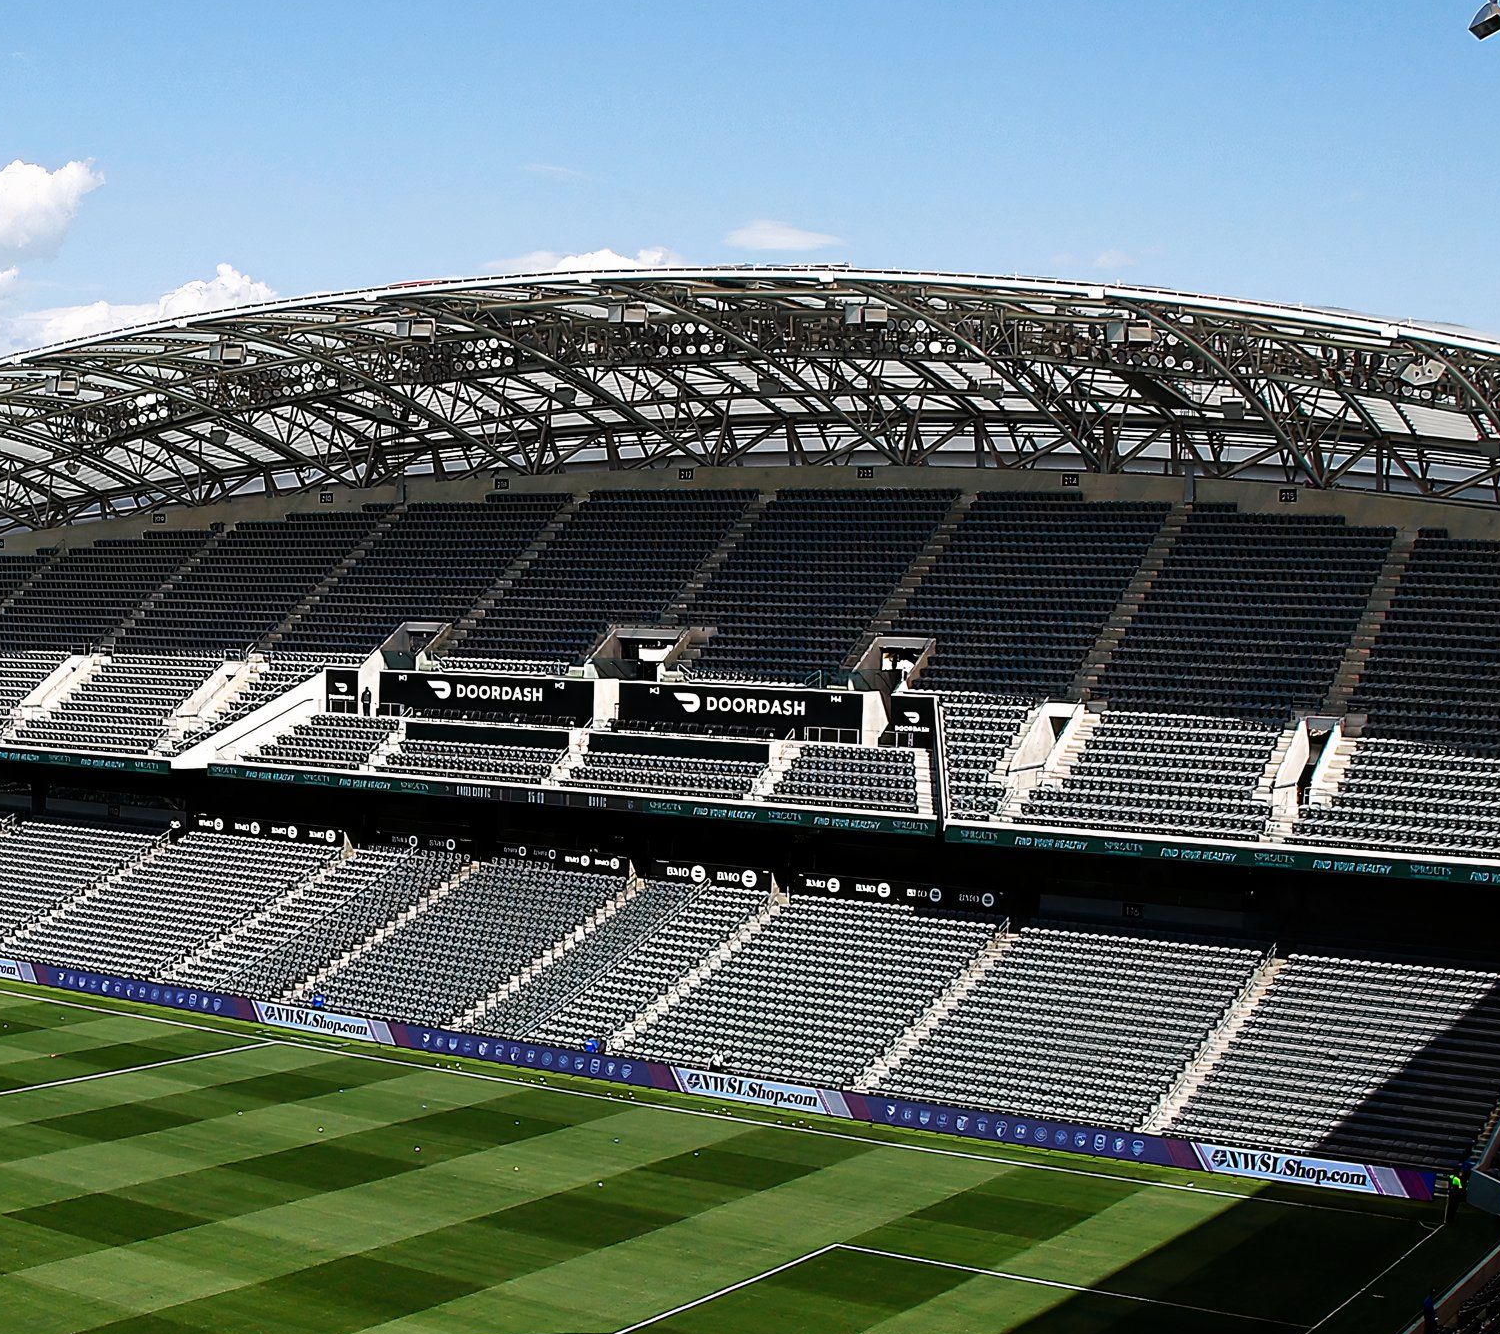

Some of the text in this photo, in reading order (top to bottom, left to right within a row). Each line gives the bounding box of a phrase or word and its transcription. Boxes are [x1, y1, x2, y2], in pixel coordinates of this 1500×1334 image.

[456, 683, 543, 702] DOORDASH
[706, 695, 806, 716] DOORDASH
[960, 829, 998, 840] SPROUTS
[1104, 840, 1144, 852] SPROUTS
[1253, 852, 1295, 864] SPROUTS
[1409, 864, 1452, 876] SPROUTS
[1470, 870, 1490, 882] FIND
[666, 866, 690, 877] BMO
[716, 870, 740, 882] BMO
[273, 1007, 368, 1035] NWSLShop.com
[699, 1074, 818, 1106] NWSLShop.com
[1226, 1151, 1367, 1186] NWSLShop.com
